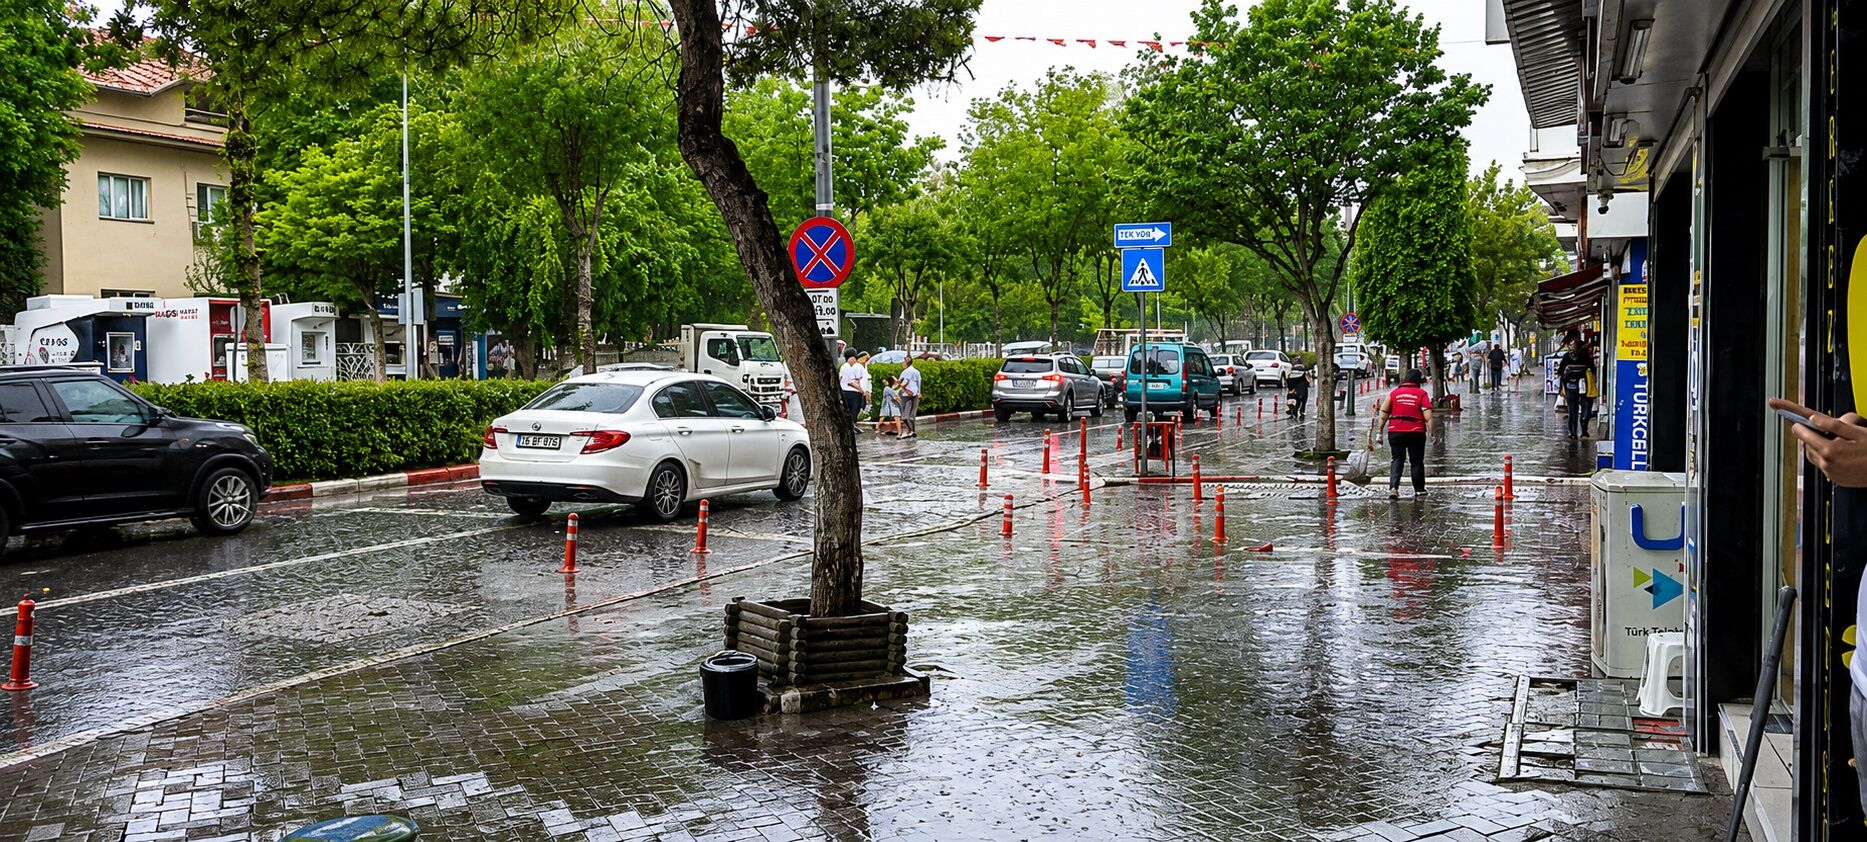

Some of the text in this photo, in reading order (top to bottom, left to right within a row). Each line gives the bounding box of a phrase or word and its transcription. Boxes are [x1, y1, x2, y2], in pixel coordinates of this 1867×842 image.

[1631, 380, 1648, 470] TURKCELL
[521, 437, 530, 445] 16
[1624, 626, 1650, 637] Türk
